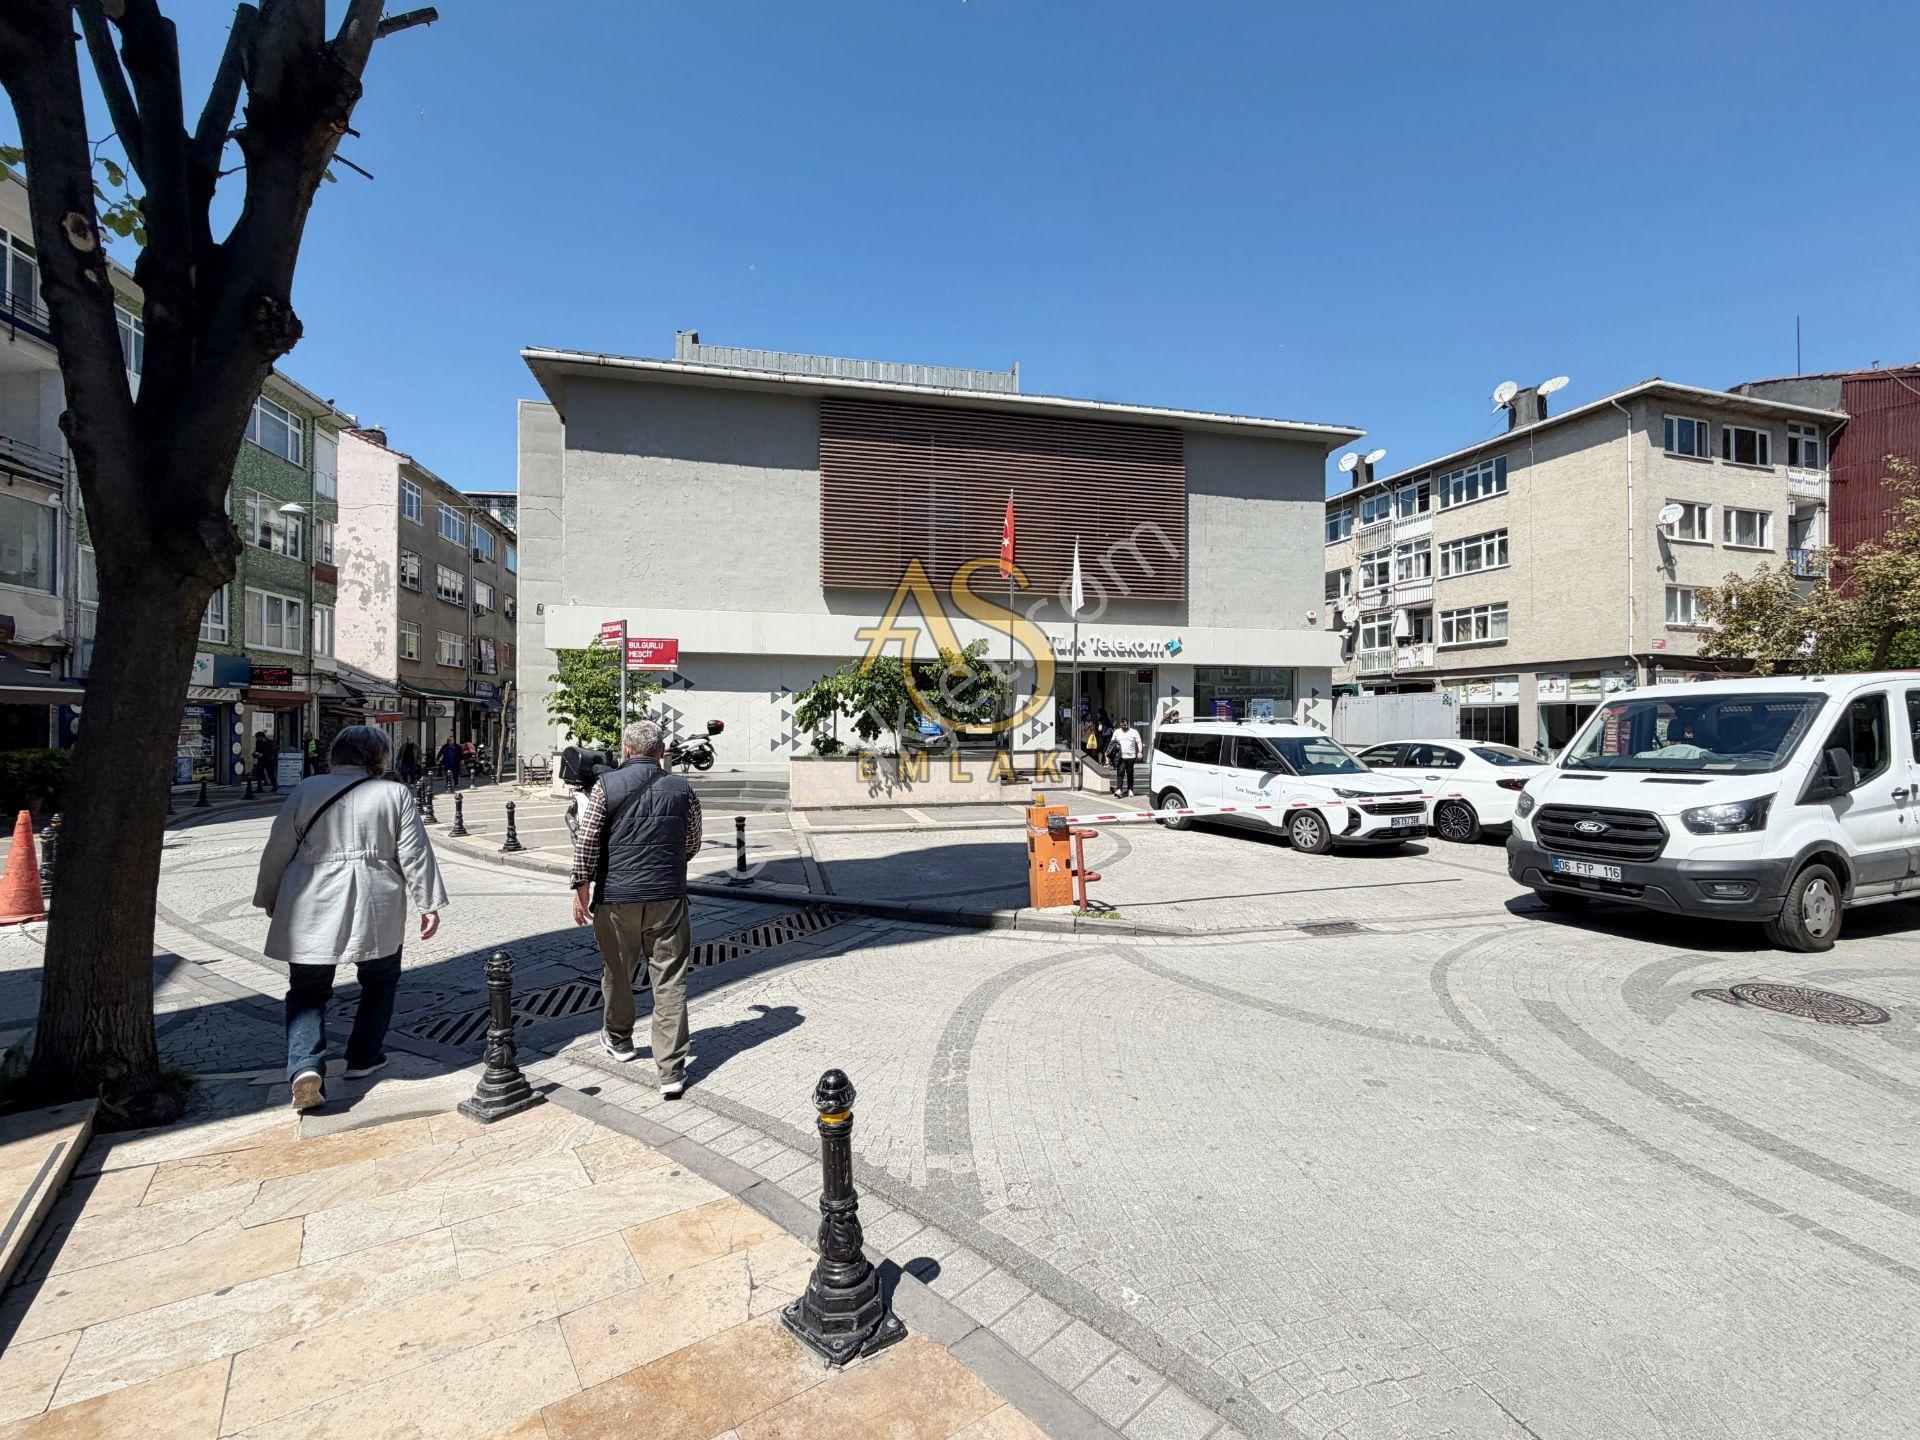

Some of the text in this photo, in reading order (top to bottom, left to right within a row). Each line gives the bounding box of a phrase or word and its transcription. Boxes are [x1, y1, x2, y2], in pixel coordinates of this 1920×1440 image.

[628, 641, 664, 649] BULGURLU
[1049, 634, 1166, 657] Türk Telekom
[628, 649, 654, 658] MESCİT
[1579, 823, 1599, 831] Ford
[1559, 860, 1620, 878] 06 FTP 116
